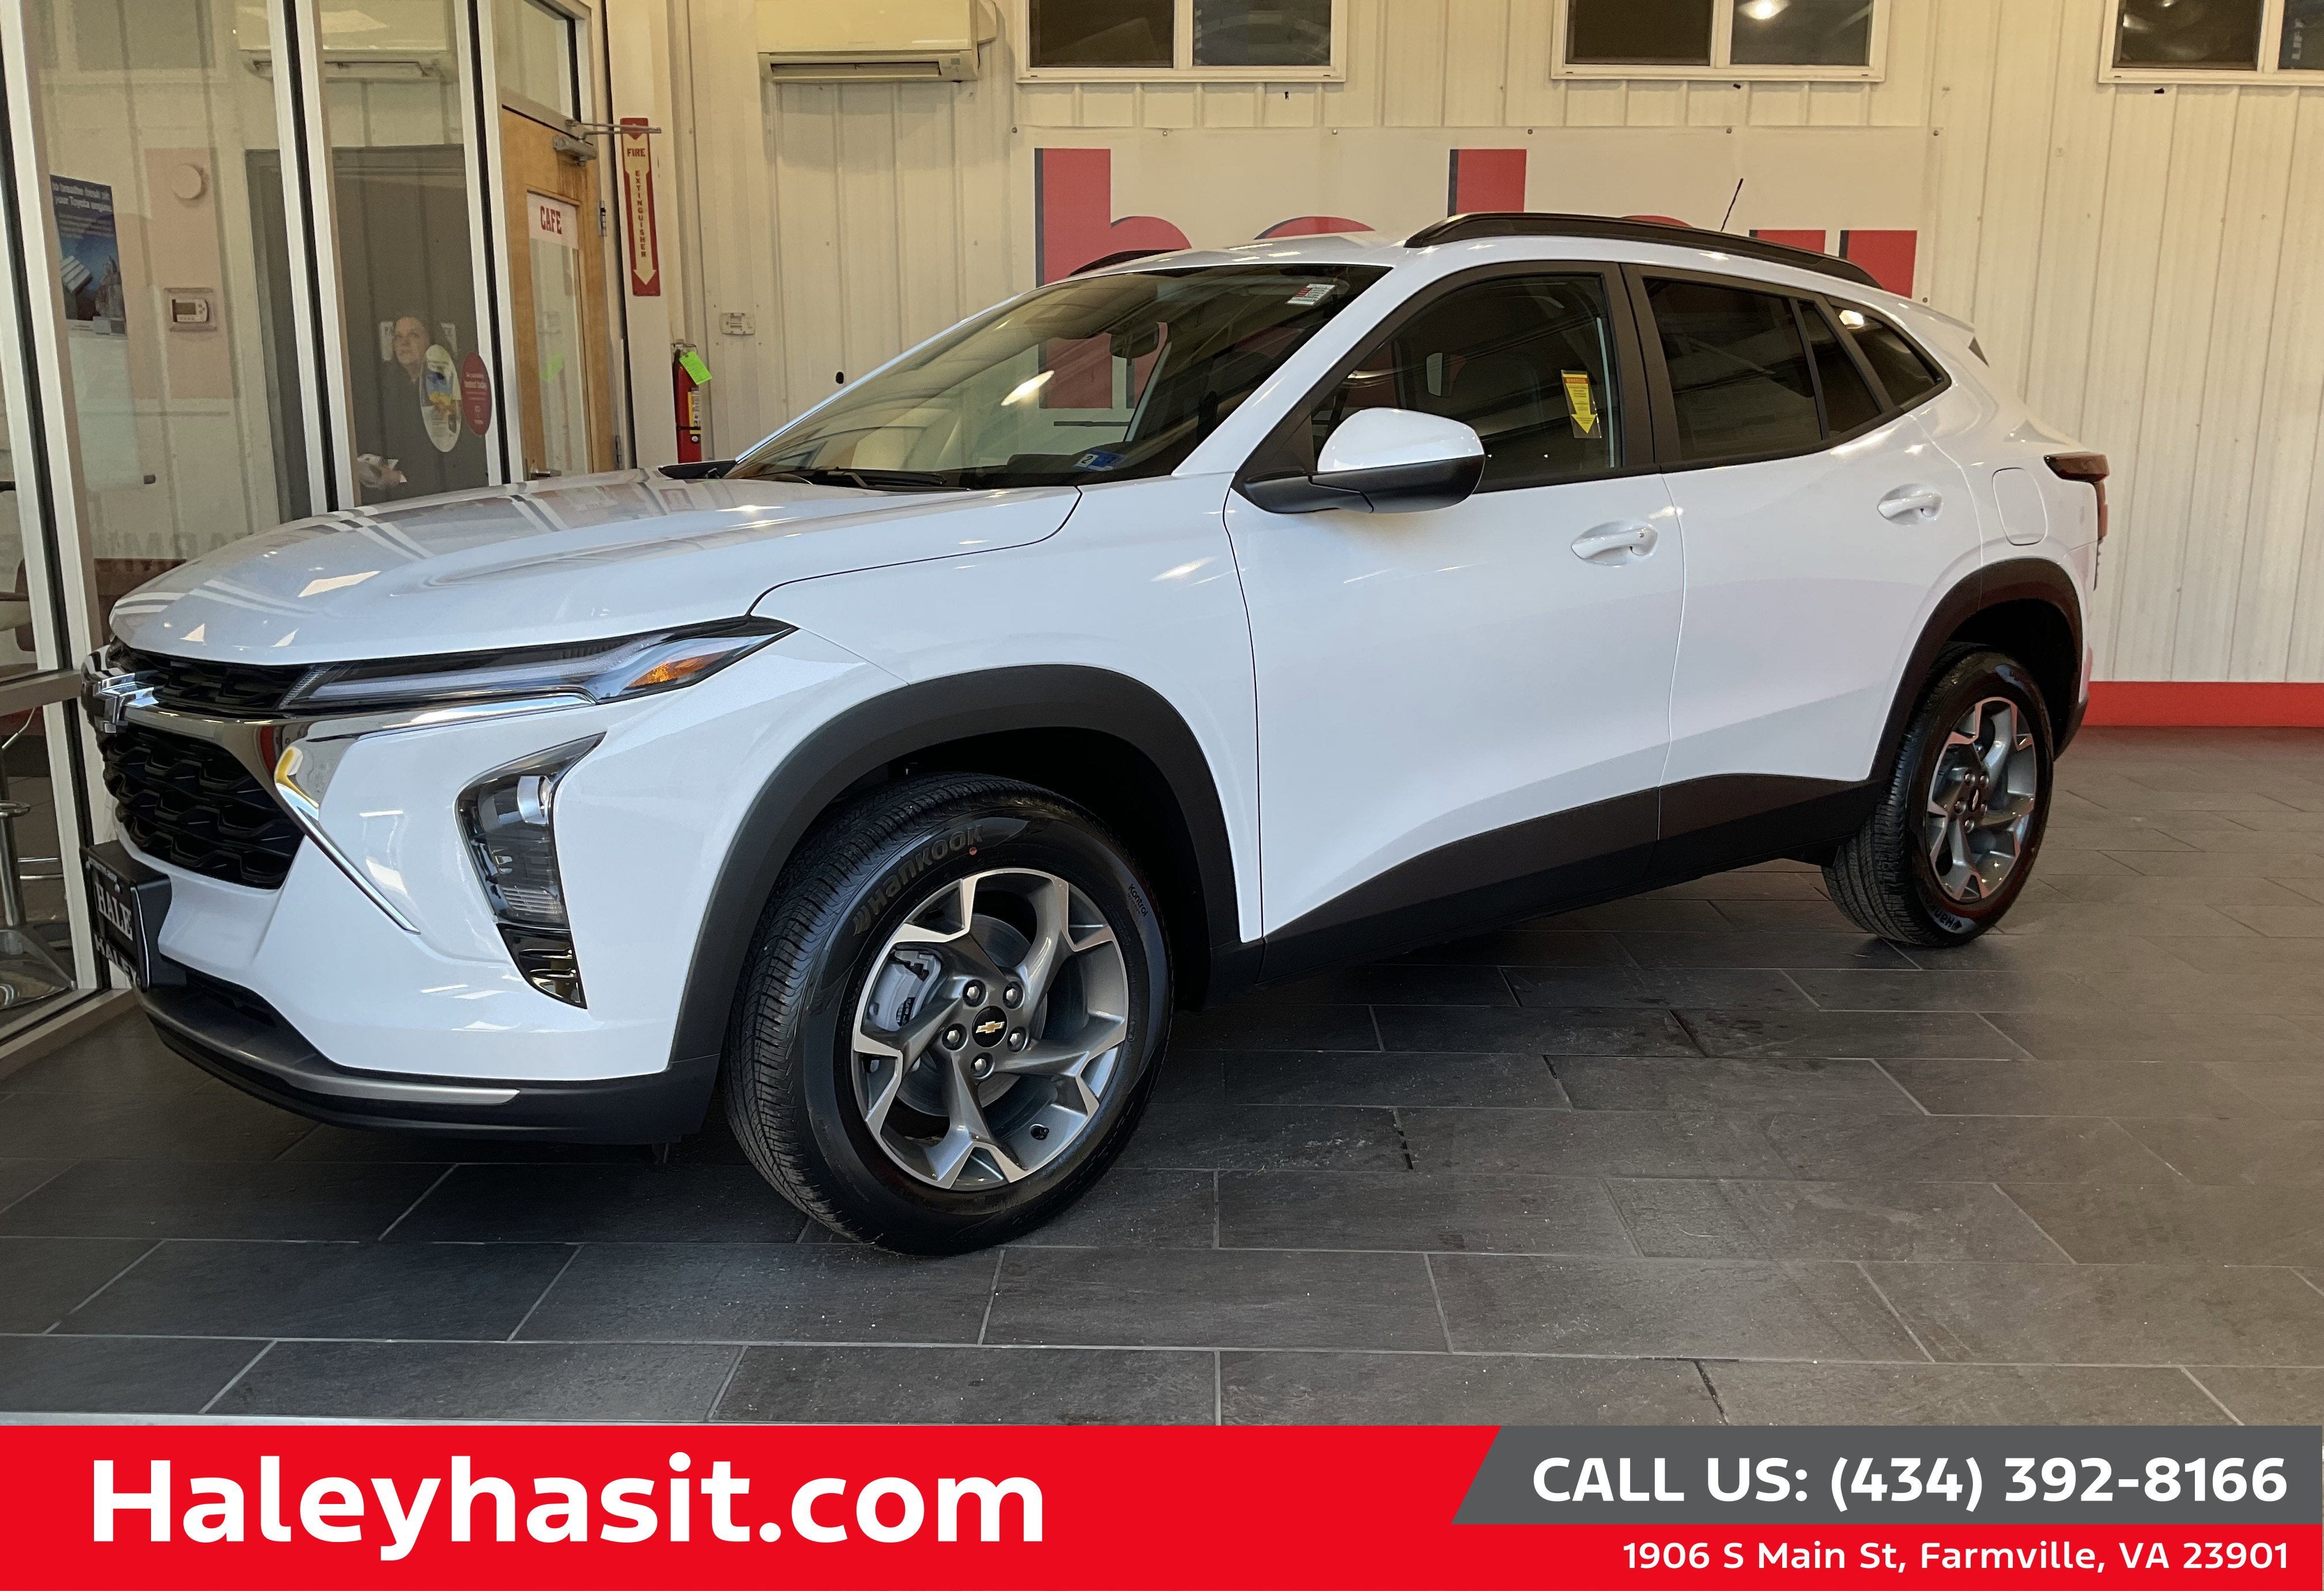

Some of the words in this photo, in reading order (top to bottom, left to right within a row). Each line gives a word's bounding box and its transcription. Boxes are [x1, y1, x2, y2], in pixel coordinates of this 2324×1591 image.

[627, 148, 646, 157] FIRE
[69, 196, 90, 209] Toyota
[635, 170, 647, 258] EXTINGUISHER
[540, 206, 562, 235] CAFE
[1128, 883, 1149, 916] Kontrol
